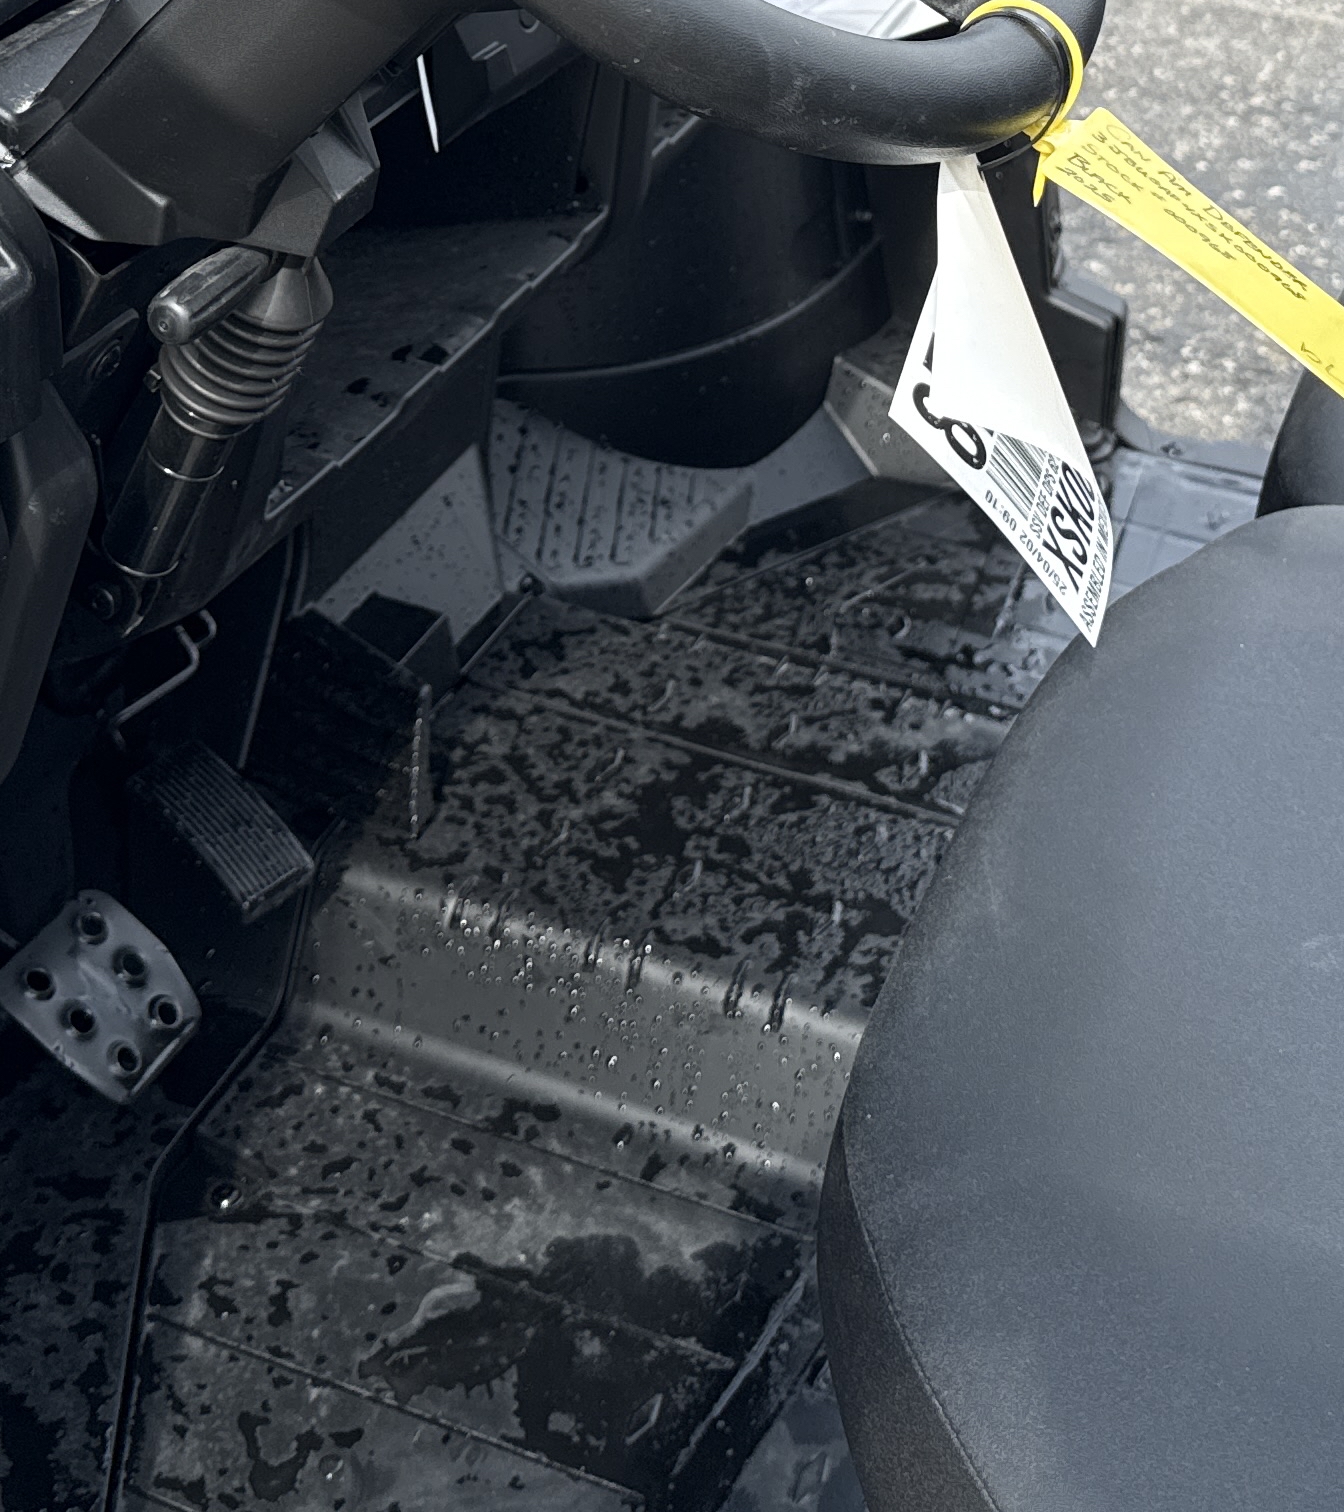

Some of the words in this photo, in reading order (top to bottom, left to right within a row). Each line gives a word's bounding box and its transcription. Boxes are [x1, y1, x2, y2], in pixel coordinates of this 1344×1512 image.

[985, 489, 1017, 531] 09:10
[1019, 529, 1067, 595] 25/04/02
[1079, 553, 1105, 633] ASSEMBLED
